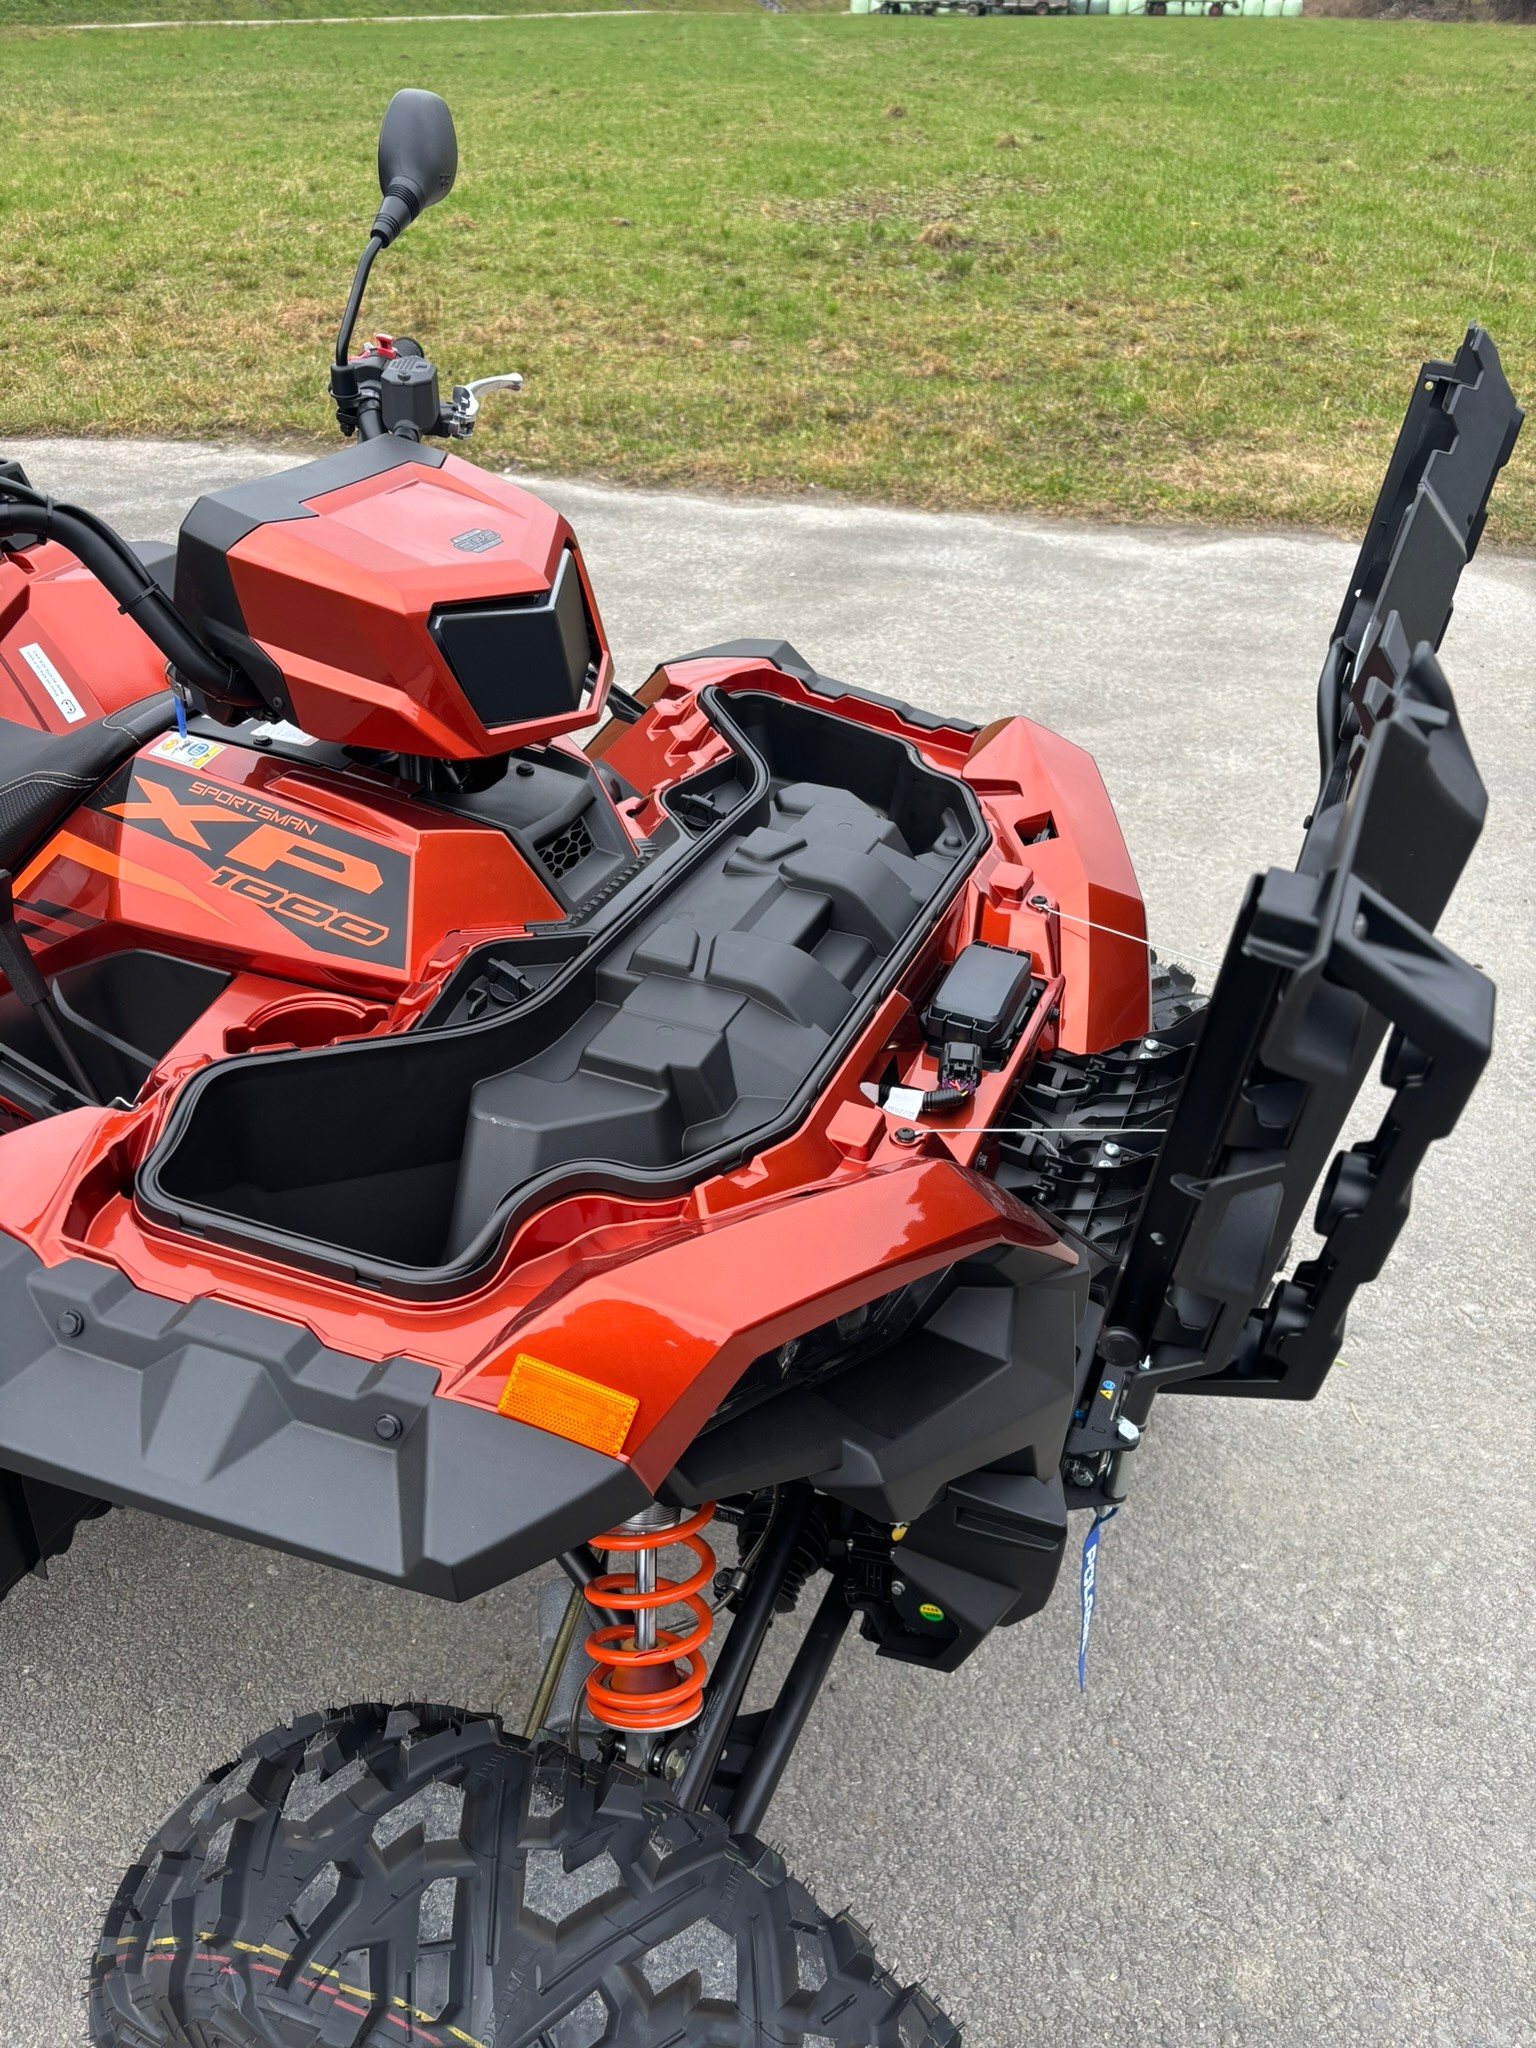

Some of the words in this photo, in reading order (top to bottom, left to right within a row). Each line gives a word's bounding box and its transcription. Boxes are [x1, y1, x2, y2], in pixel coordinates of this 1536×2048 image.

[102, 775, 384, 895] XP
[188, 781, 319, 836] SPORTSMAN
[204, 865, 389, 947] 1000
